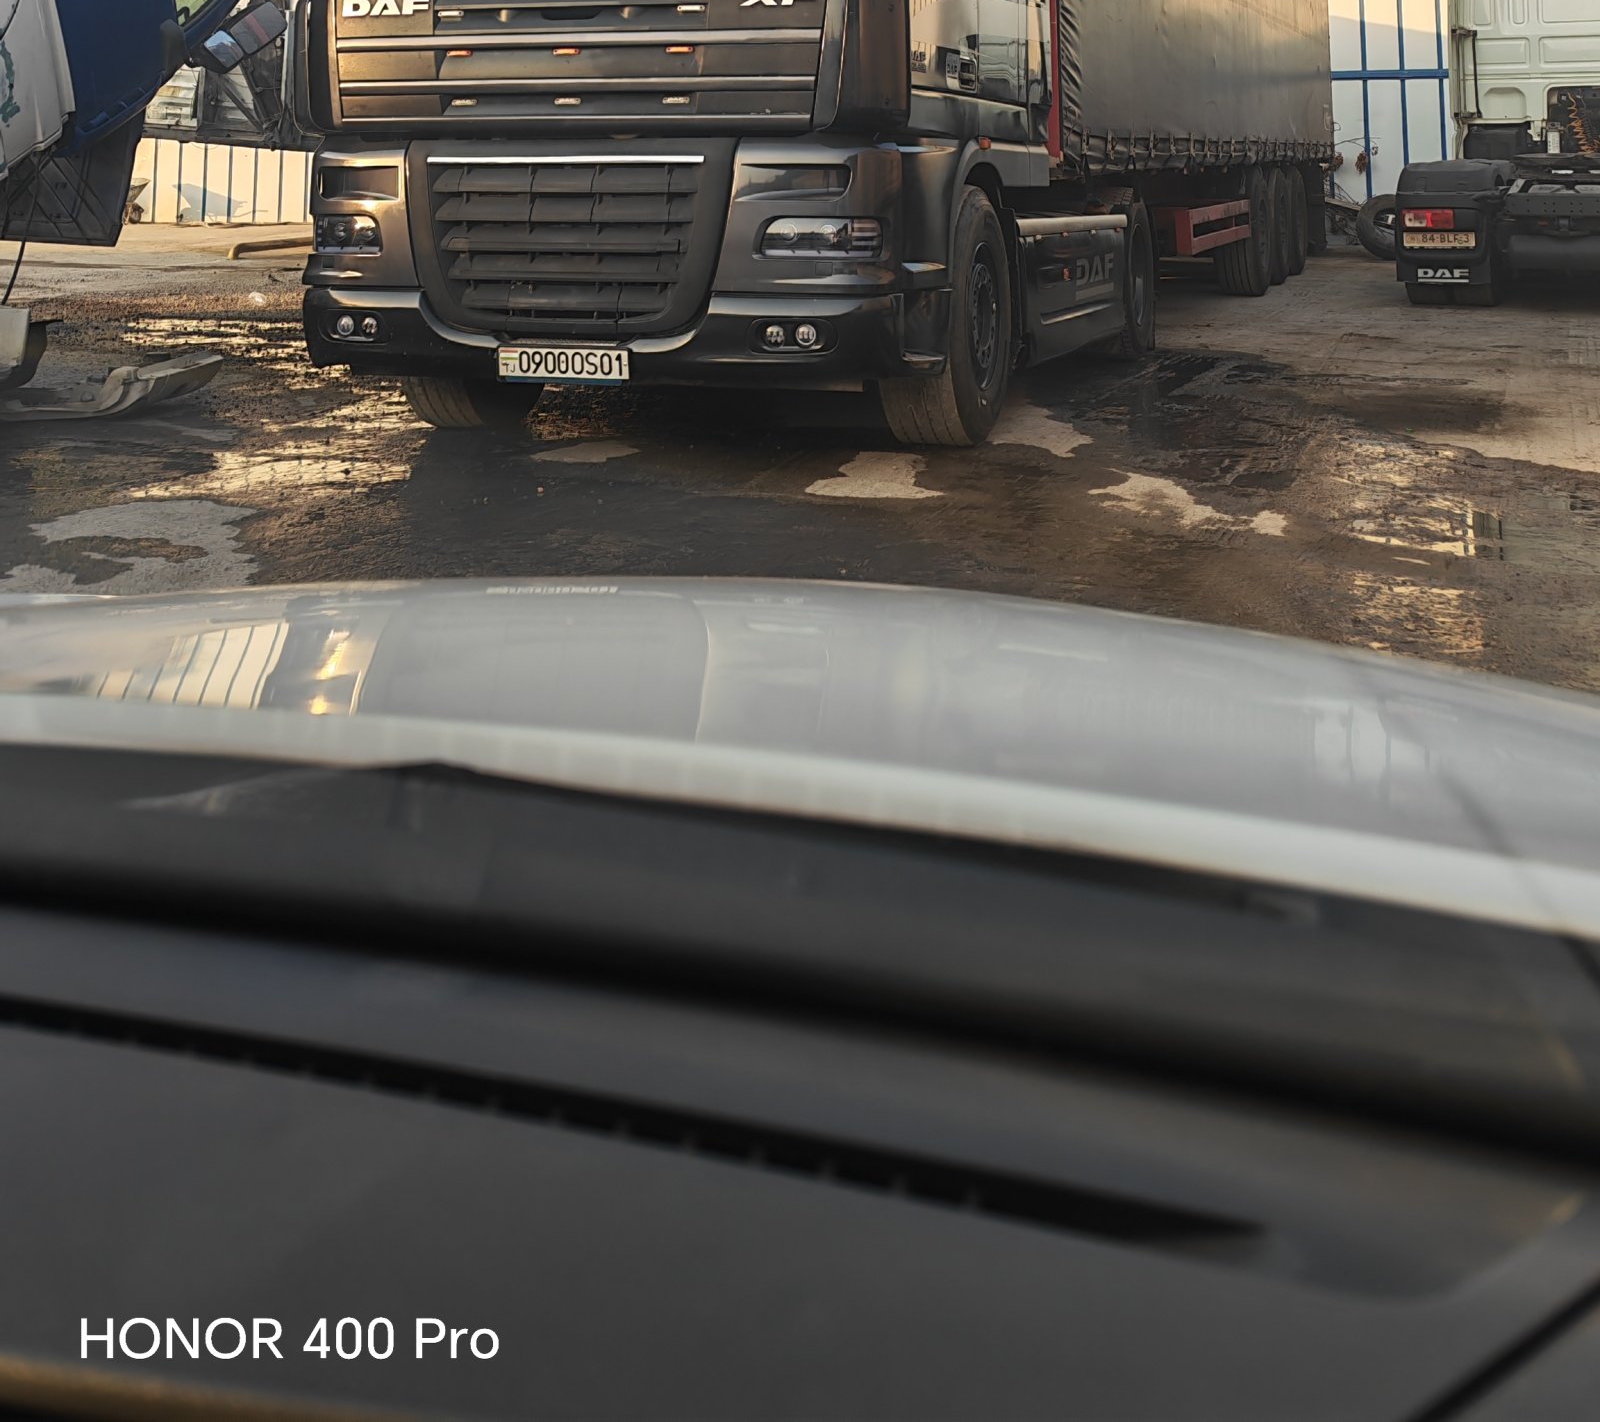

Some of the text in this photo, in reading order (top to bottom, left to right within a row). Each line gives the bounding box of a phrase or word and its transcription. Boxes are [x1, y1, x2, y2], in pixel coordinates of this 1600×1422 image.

[1076, 253, 1114, 287] DAF
[1418, 268, 1469, 278] DAF
[504, 362, 516, 373] TJ
